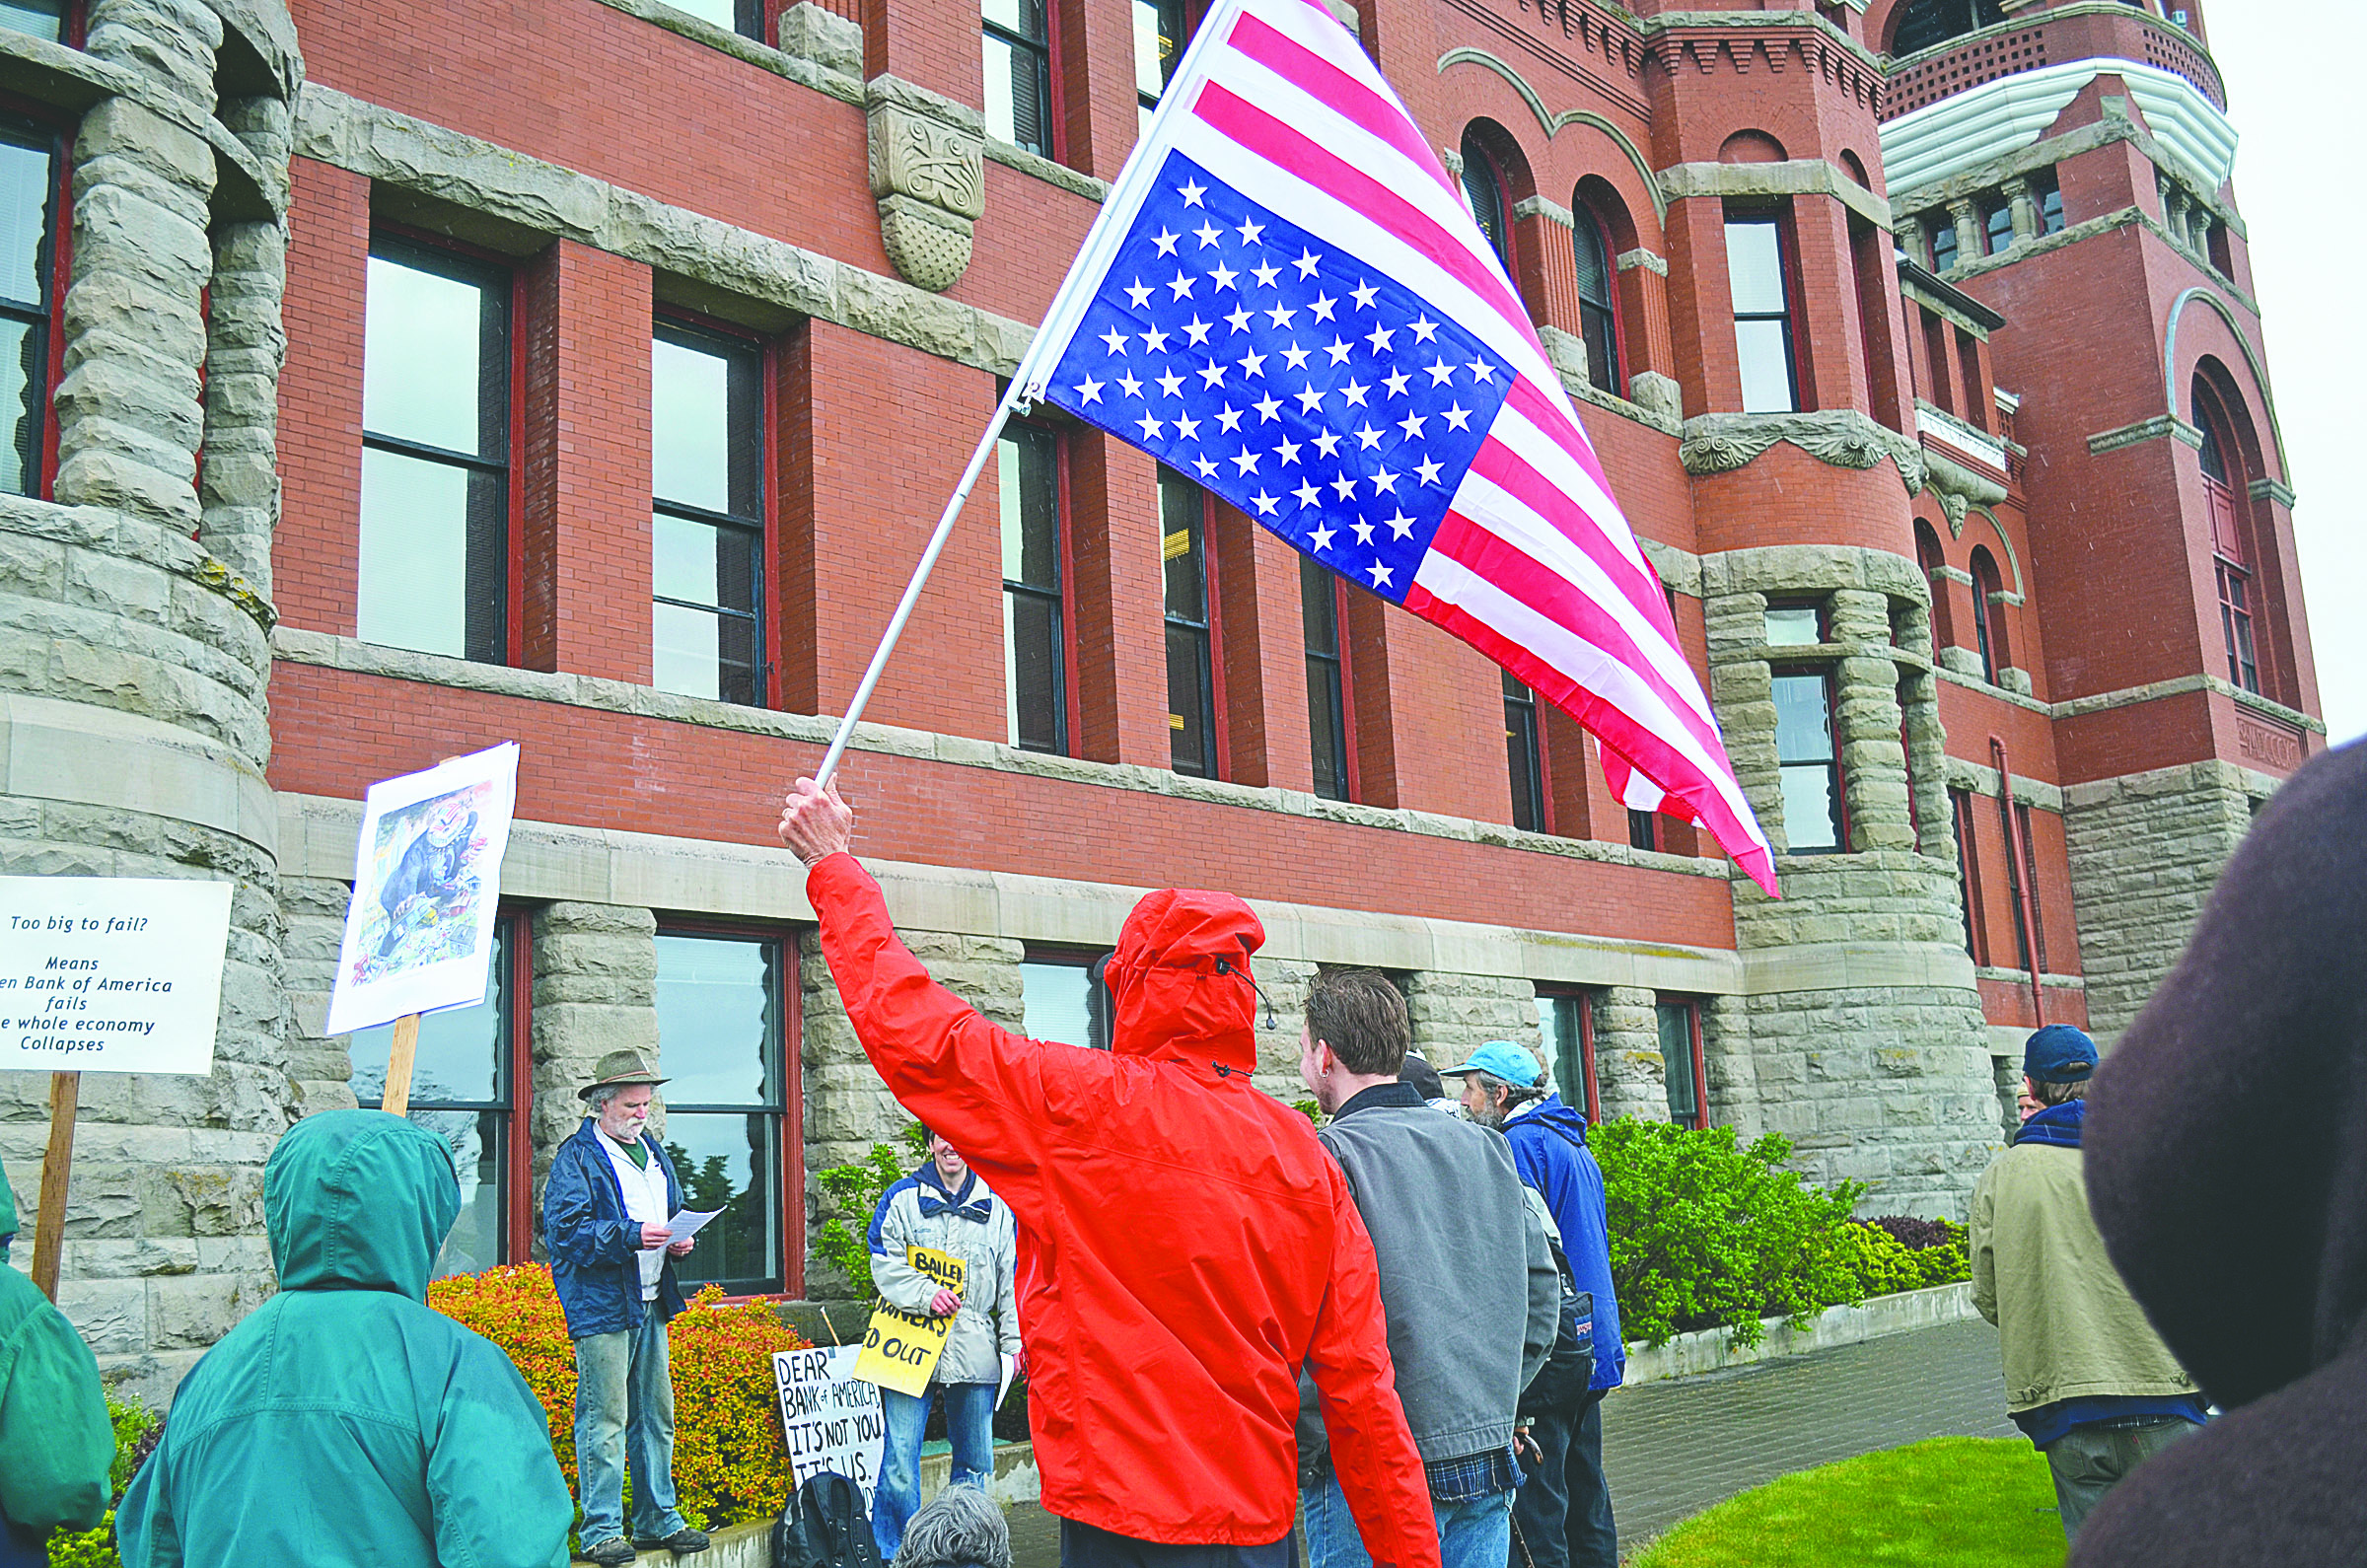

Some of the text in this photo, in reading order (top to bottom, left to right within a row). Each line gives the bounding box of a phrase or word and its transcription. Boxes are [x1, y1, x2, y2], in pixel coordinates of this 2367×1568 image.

[11, 915, 148, 934] Too big to fail?
[44, 957, 99, 970] Means
[24, 975, 66, 989] Bank
[72, 976, 93, 993] of
[97, 976, 173, 992] America
[44, 995, 88, 1013] fails
[18, 1015, 68, 1030] whole
[75, 1020, 155, 1035] economy
[21, 1035, 105, 1054] Collapses
[914, 1252, 963, 1284] BAILED
[883, 1337, 931, 1365] OUT
[778, 1350, 830, 1386] DEAR
[782, 1386, 822, 1420] BANK
[821, 1389, 828, 1404] of
[789, 1420, 824, 1456] IT'S
[825, 1418, 848, 1449] NOT
